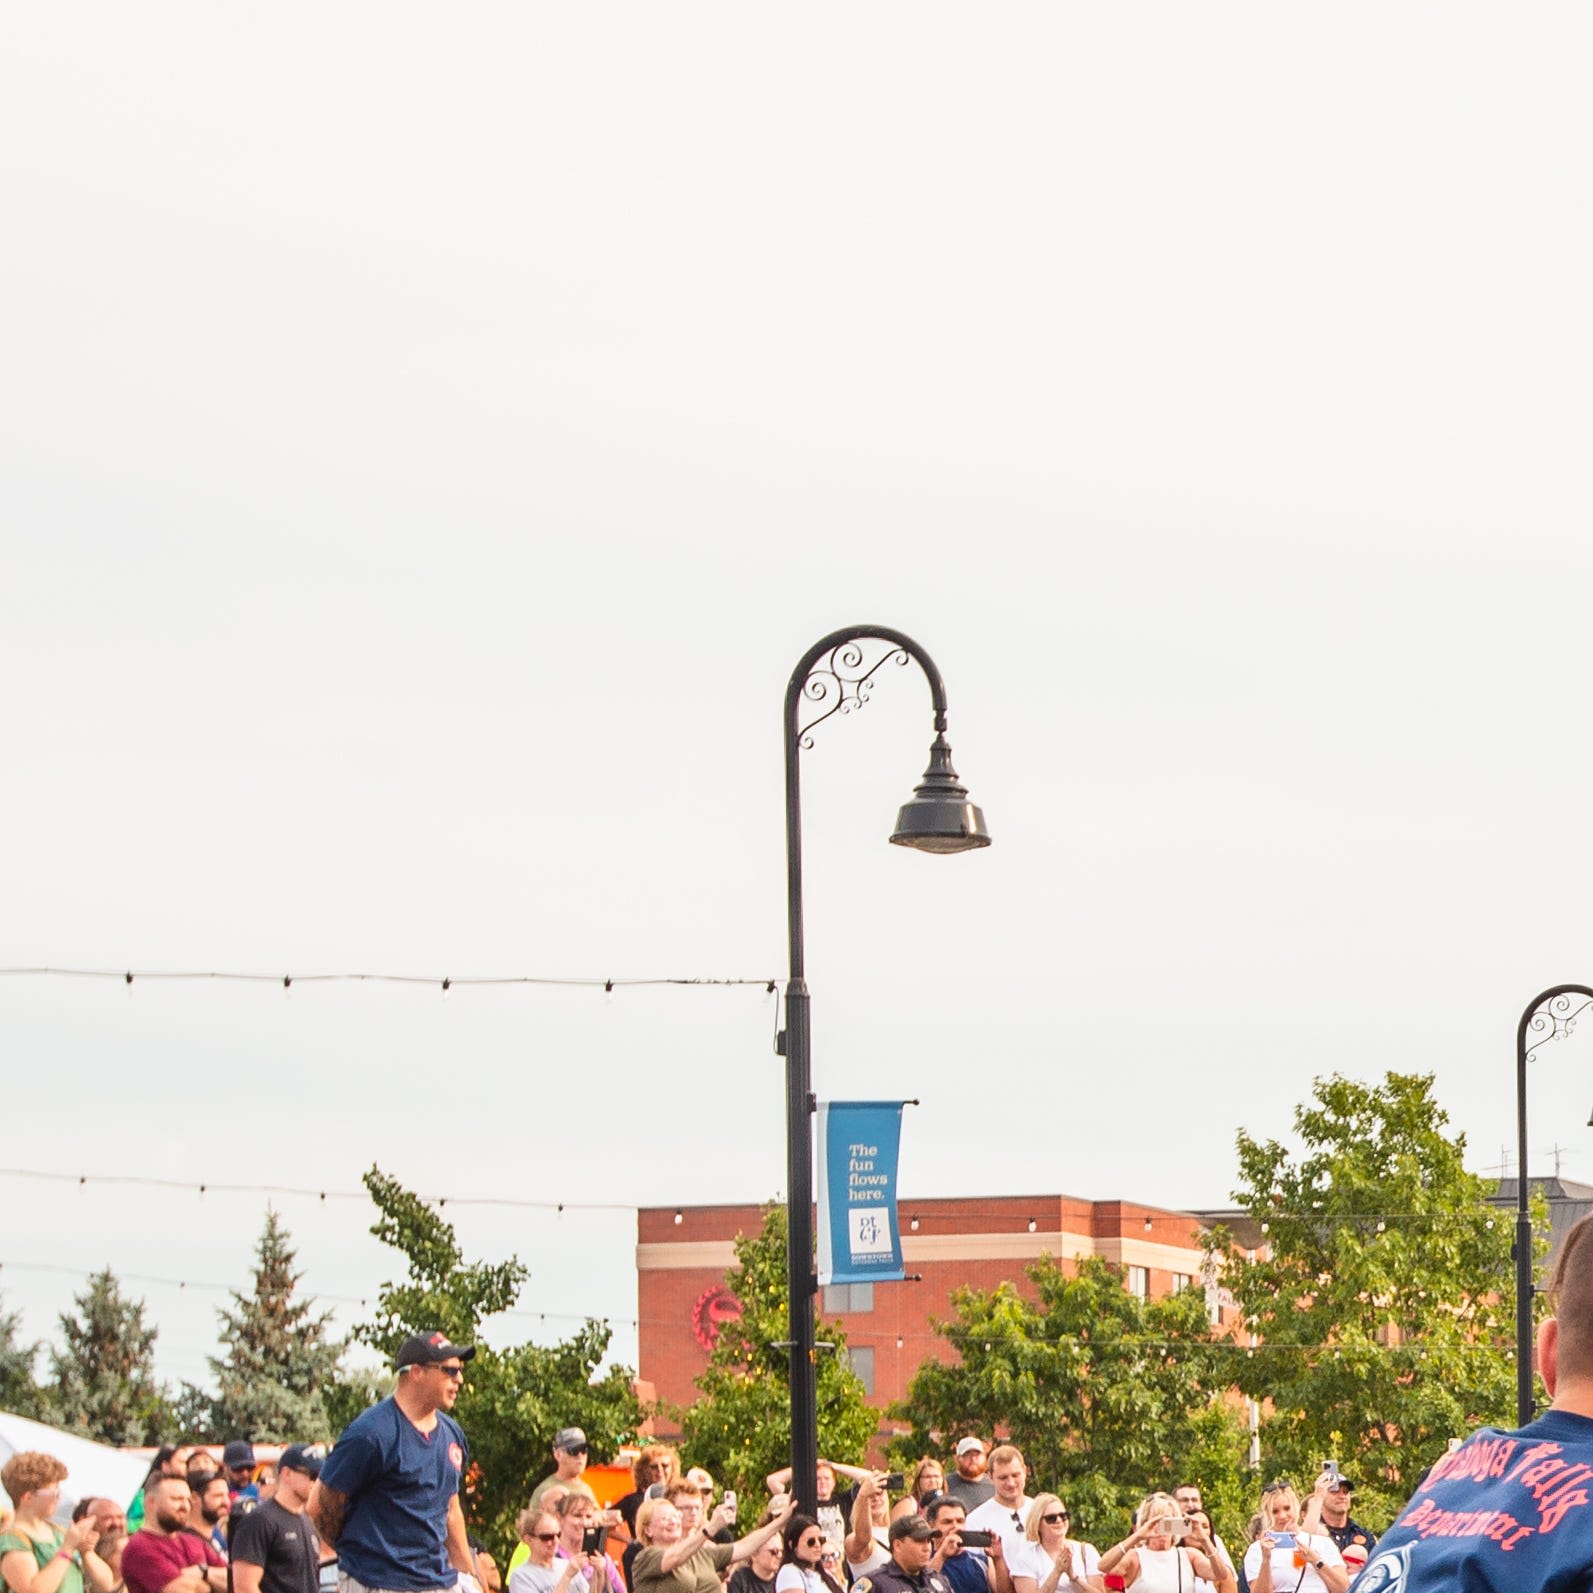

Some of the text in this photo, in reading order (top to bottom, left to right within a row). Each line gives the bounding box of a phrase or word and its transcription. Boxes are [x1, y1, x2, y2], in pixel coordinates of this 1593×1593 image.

[849, 1143, 878, 1158] The
[849, 1158, 874, 1172] fun
[849, 1173, 888, 1187] flows
[849, 1188, 885, 1200] here.
